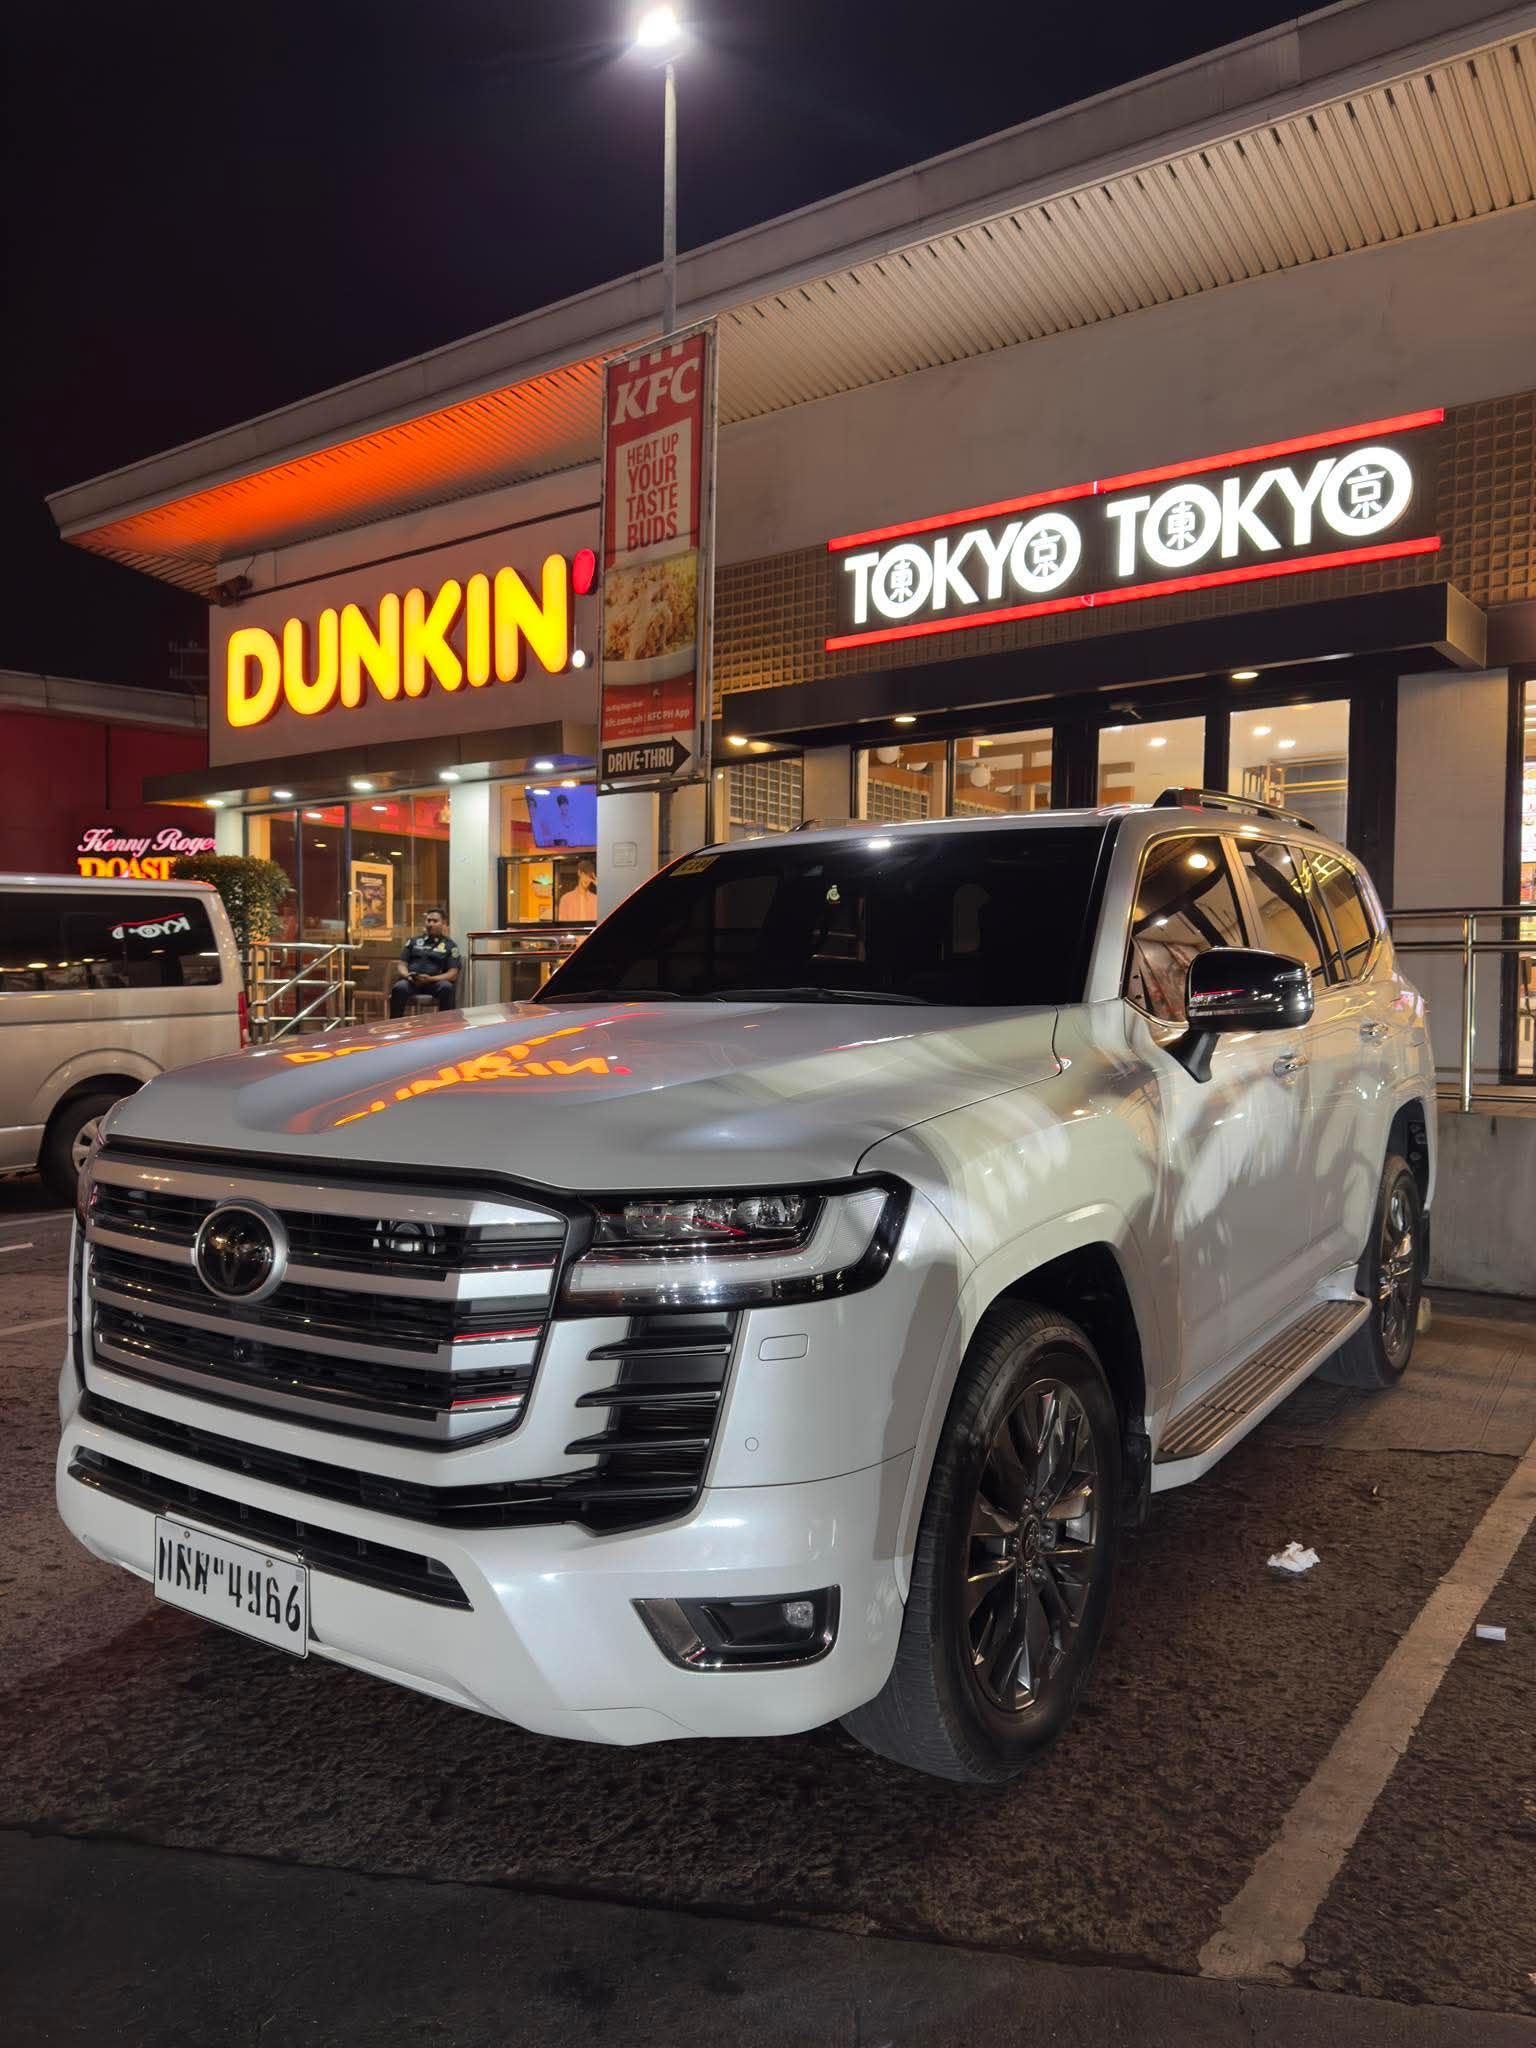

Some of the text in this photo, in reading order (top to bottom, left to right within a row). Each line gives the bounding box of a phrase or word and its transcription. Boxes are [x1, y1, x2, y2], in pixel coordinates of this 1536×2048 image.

[611, 357, 700, 426] KFC
[627, 432, 679, 467] HEAT UP
[628, 454, 677, 493] YOUR
[1346, 466, 1387, 518] 京
[626, 482, 678, 522] TASTE
[627, 511, 677, 552] BUDS
[844, 447, 1413, 625] TOKYO TOKYO
[647, 711, 662, 722] KFC
[608, 745, 674, 774] DRIVE-THRU
[77, 828, 216, 857] Kenny Roge
